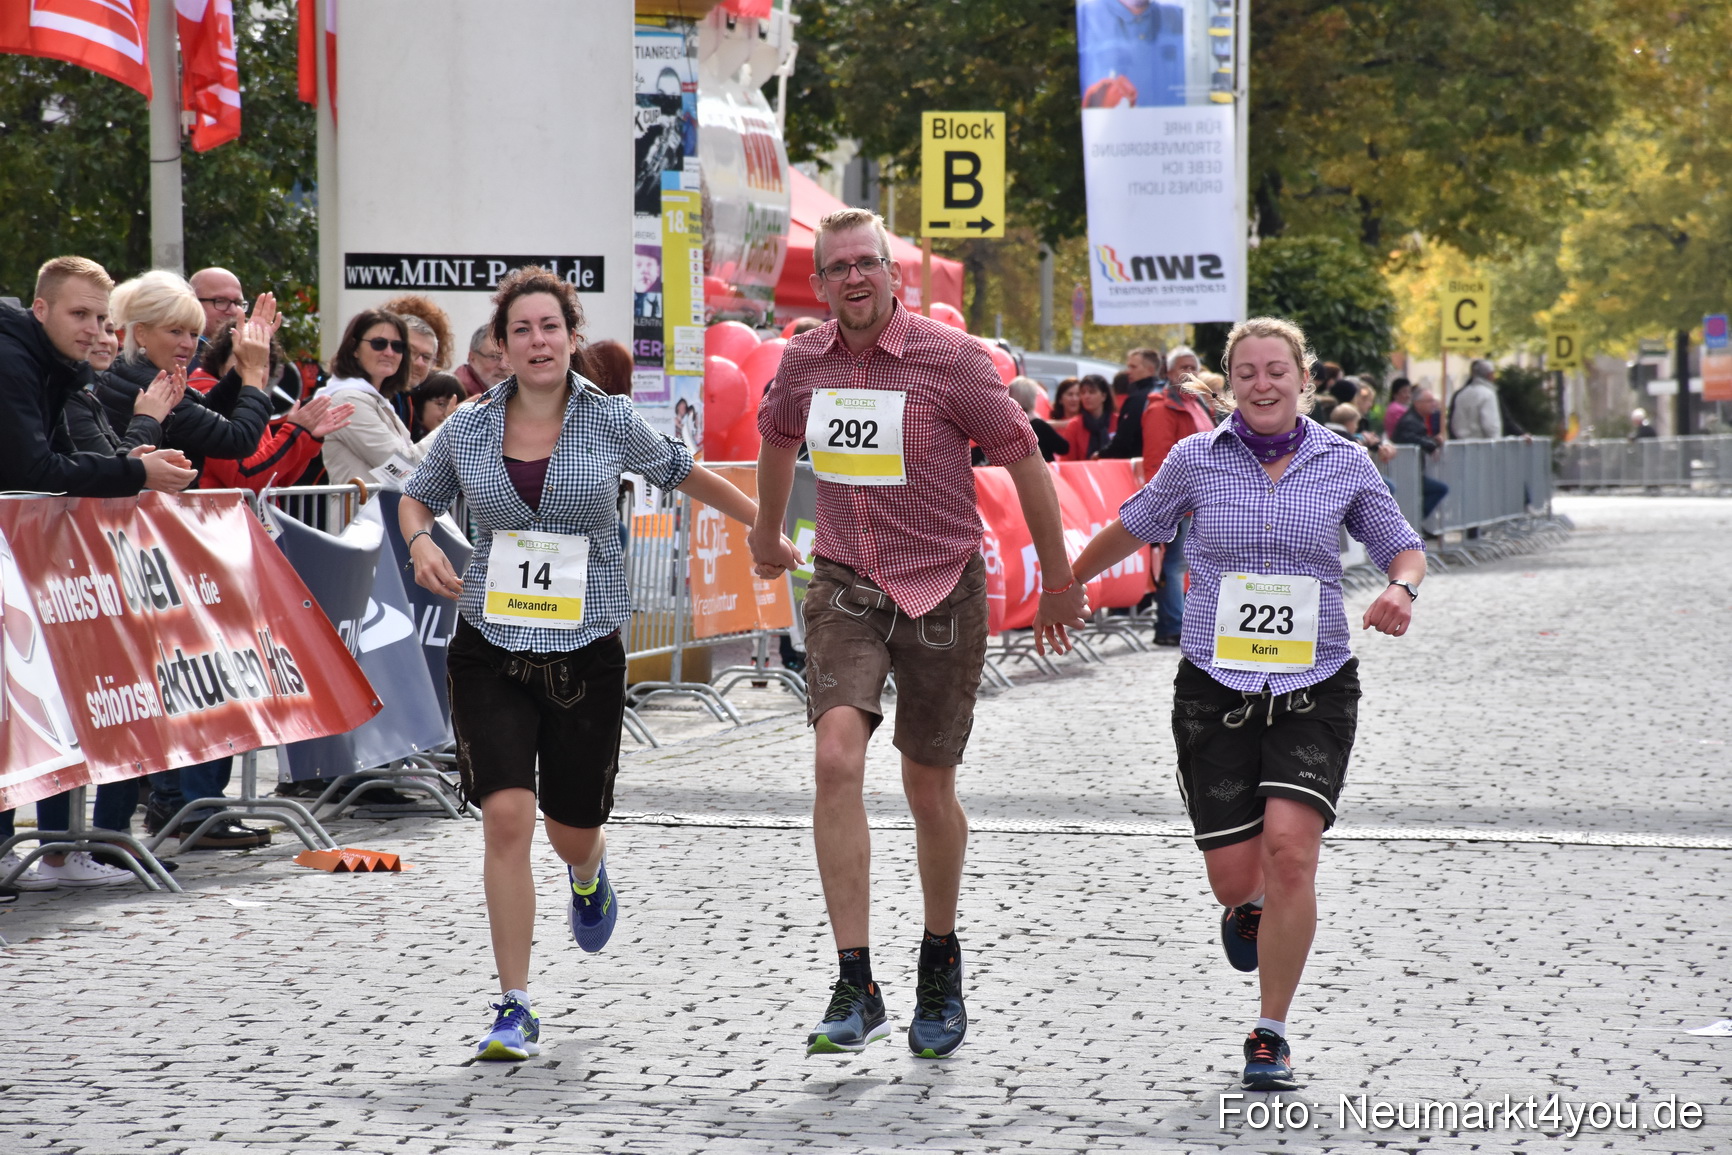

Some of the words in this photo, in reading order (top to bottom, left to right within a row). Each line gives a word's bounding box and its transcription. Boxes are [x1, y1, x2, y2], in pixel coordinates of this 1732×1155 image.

[932, 118, 995, 139] Block
[944, 151, 984, 209] B
[665, 210, 688, 233] 18.
[635, 231, 656, 240] BERG
[1449, 281, 1484, 293] Block
[1454, 298, 1478, 331] C
[1556, 335, 1573, 359] D
[844, 398, 876, 407] BOCK
[828, 418, 878, 448] 292
[525, 539, 560, 551] BOCK
[518, 560, 552, 590] 14
[1255, 583, 1291, 593] BOCK
[507, 598, 557, 612] Alexandra
[1239, 603, 1294, 635] 223
[1252, 643, 1278, 656] Karin
